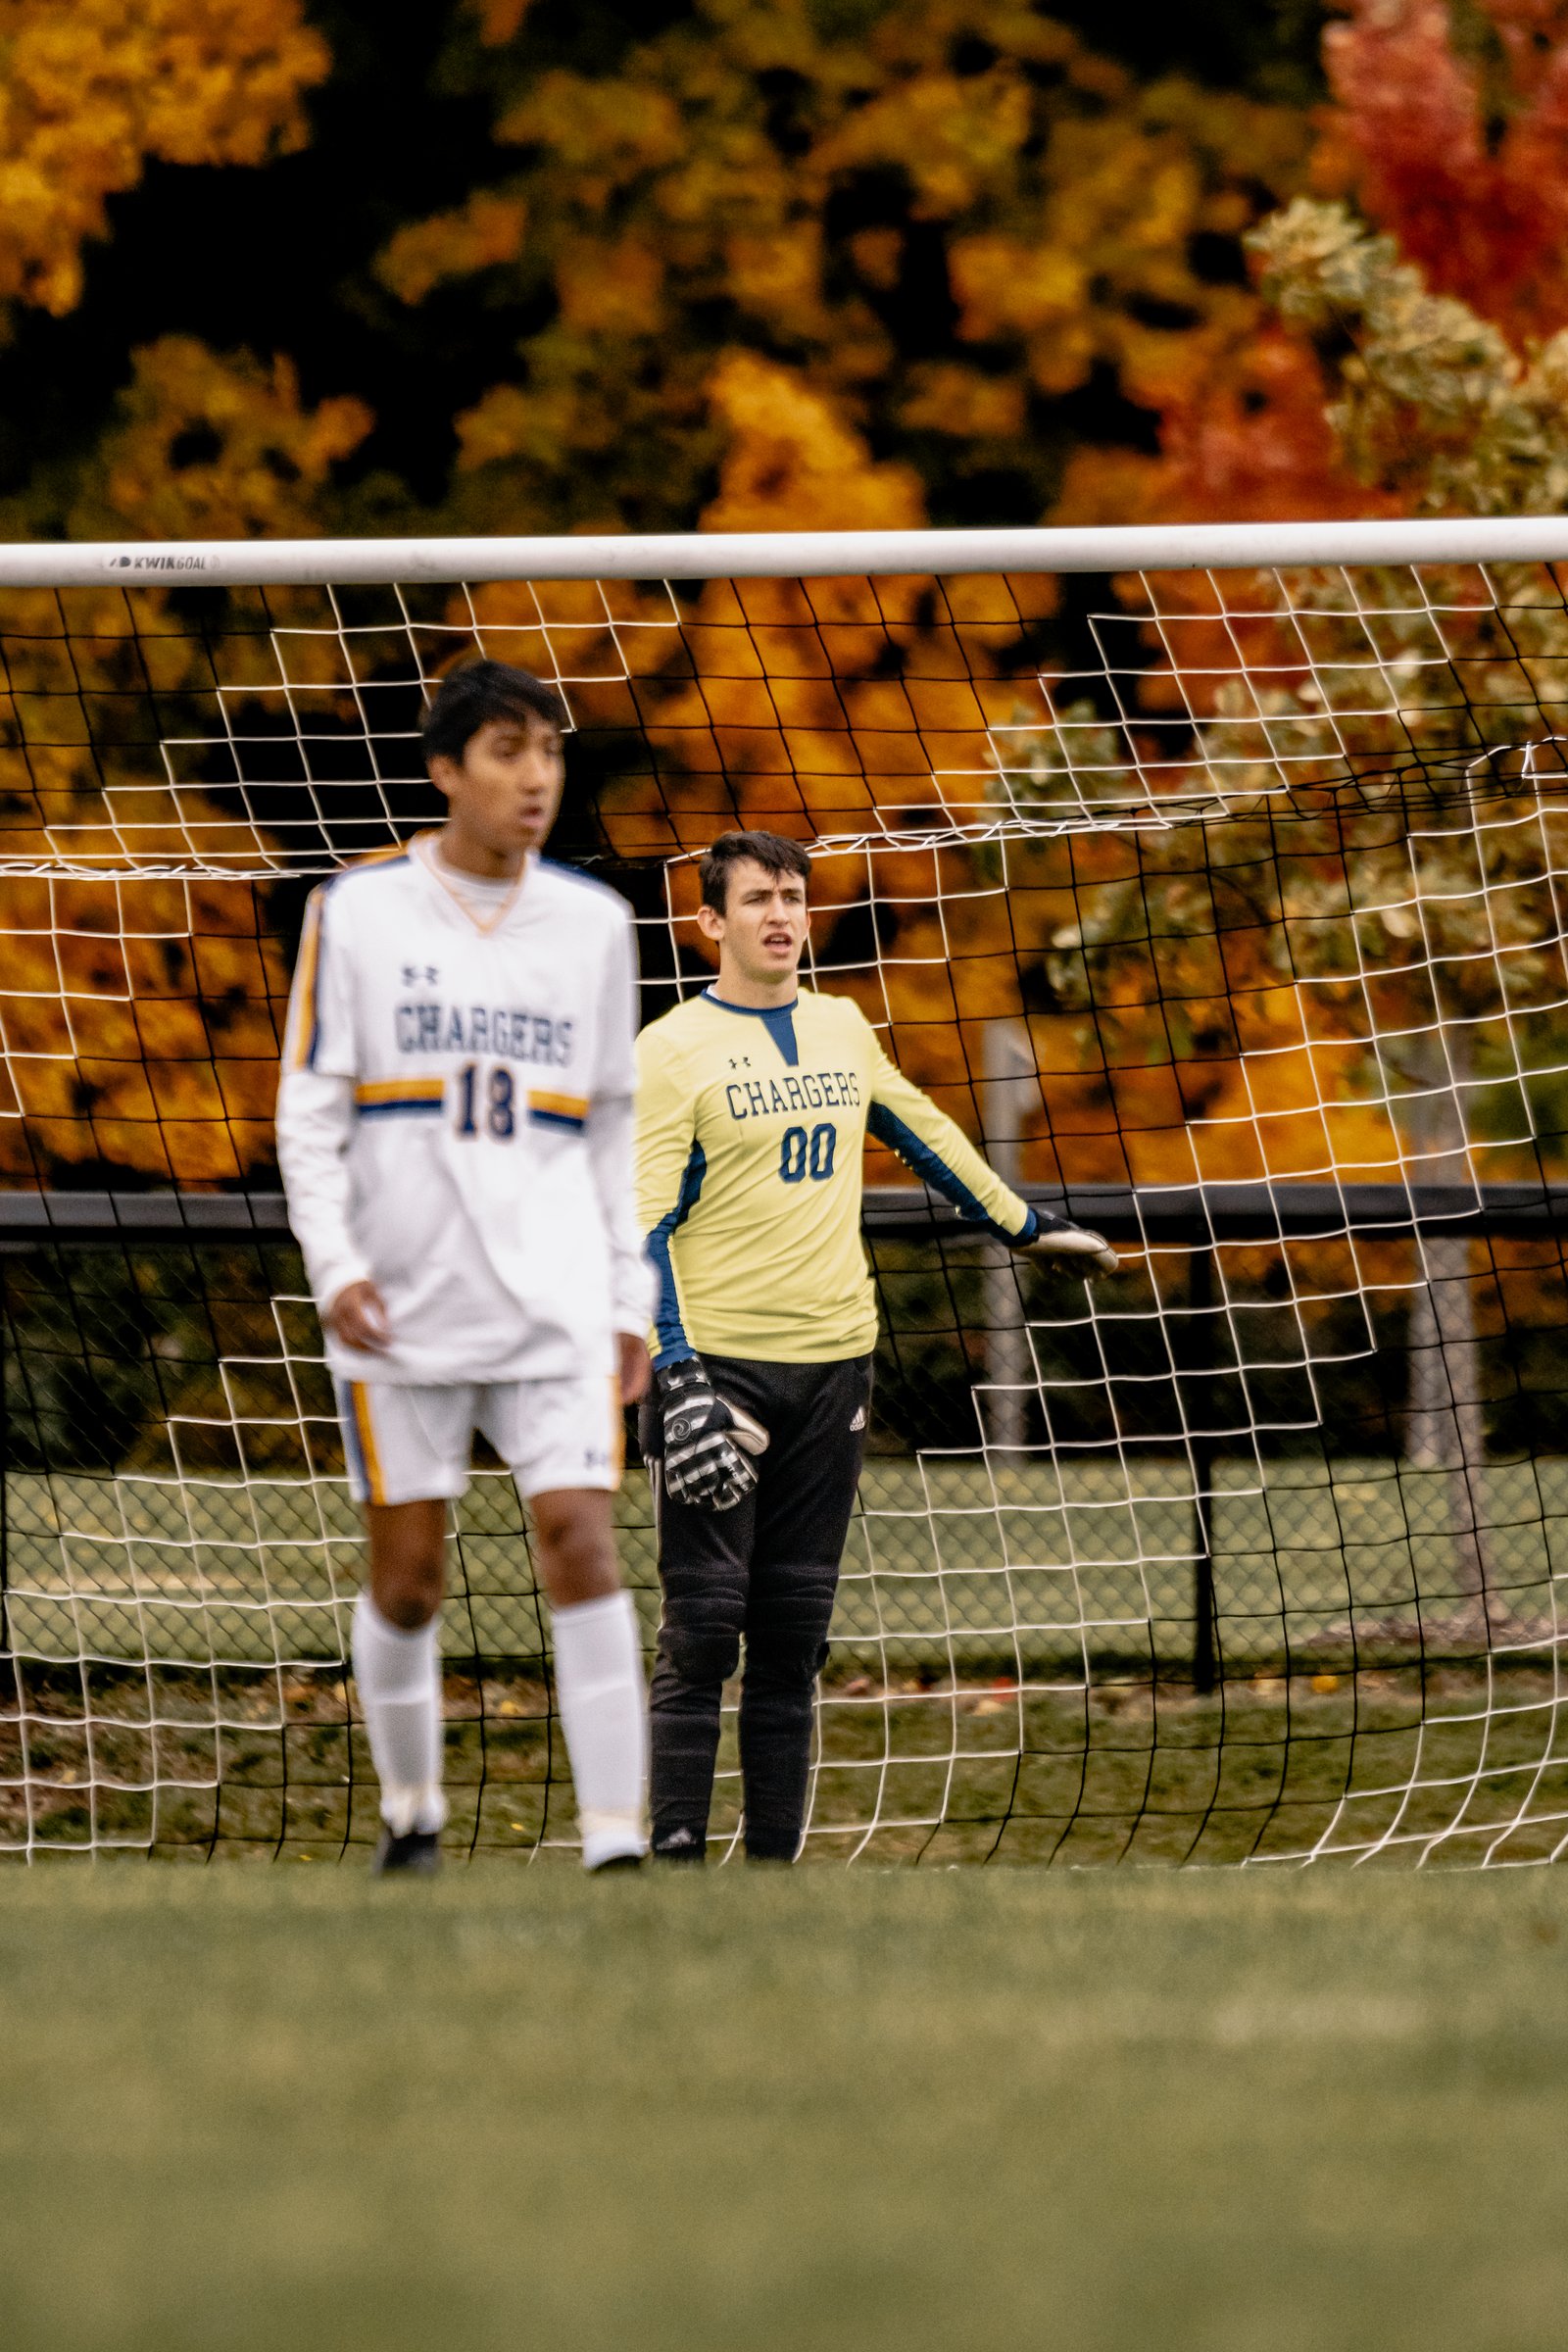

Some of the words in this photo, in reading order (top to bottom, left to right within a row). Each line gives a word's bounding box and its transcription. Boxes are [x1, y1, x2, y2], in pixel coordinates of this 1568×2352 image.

[396, 1005, 572, 1067] CHARGERS
[455, 1059, 515, 1143] 18
[726, 1072, 860, 1120] CHARGERS
[778, 1123, 837, 1184] 00
